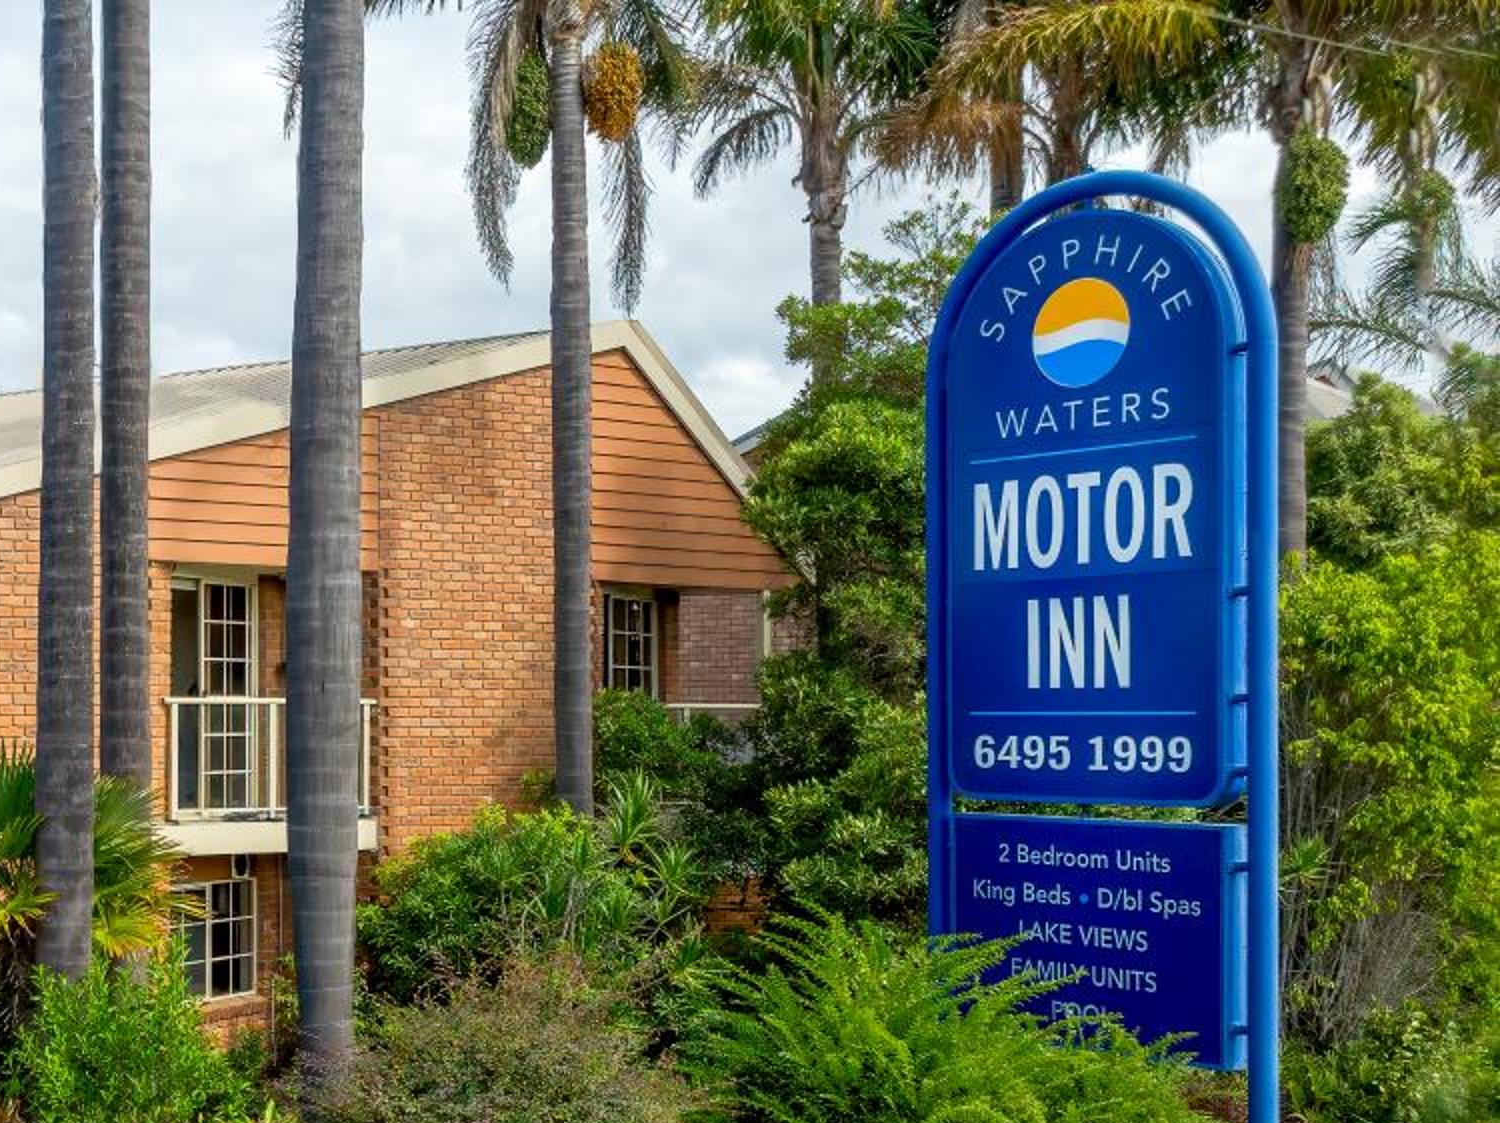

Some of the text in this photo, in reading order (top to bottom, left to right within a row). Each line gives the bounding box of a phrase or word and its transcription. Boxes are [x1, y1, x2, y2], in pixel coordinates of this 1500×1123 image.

[980, 235, 1193, 342] SAPPHIRE
[995, 387, 1170, 439] WATERS
[973, 463, 1193, 571] MOTOR
[1027, 594, 1131, 689] INN
[973, 734, 1193, 773] 6495 1999
[998, 843, 1171, 873] 2 Bedroom Units
[973, 879, 1201, 919] King Beds D/bl Spas
[1078, 925, 1148, 952] VIEWS
[1092, 965, 1157, 993] UNITS
